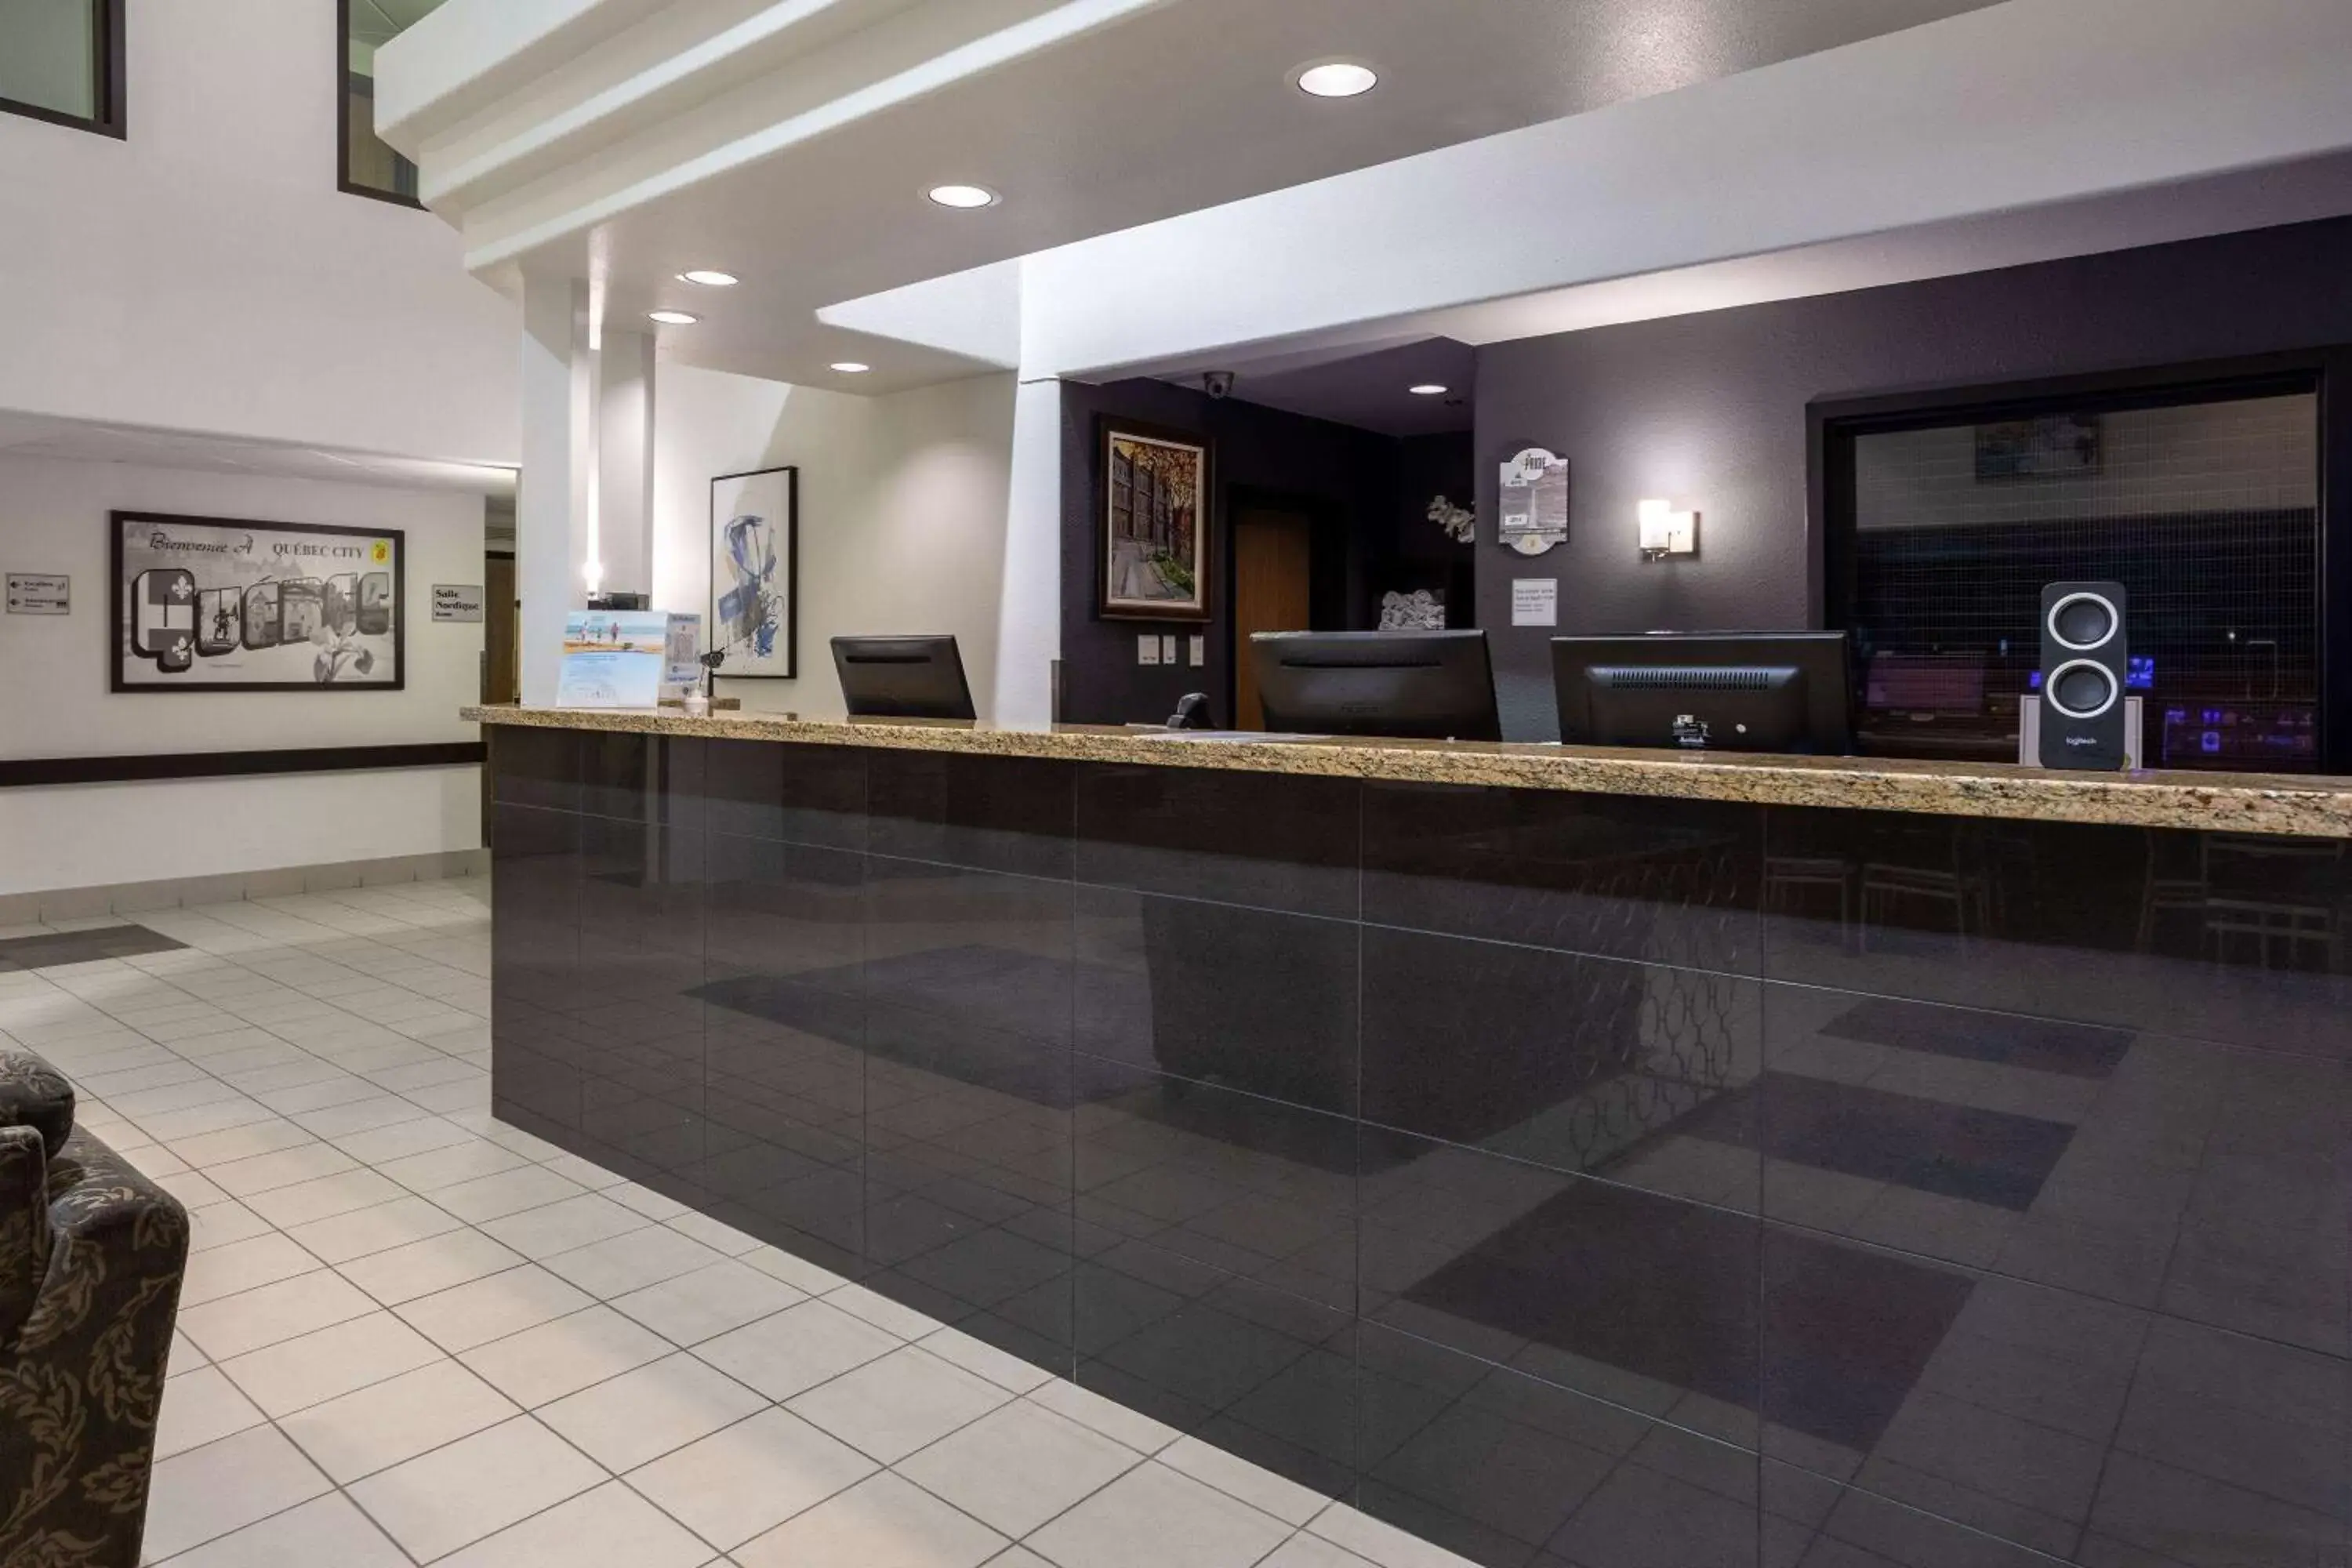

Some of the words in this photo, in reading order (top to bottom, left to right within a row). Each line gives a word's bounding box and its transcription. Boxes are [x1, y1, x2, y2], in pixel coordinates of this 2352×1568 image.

[273, 541, 328, 557] QUÉBEC
[332, 546, 363, 559] CITY
[435, 589, 459, 598] Salle
[435, 601, 480, 612] Nordique
